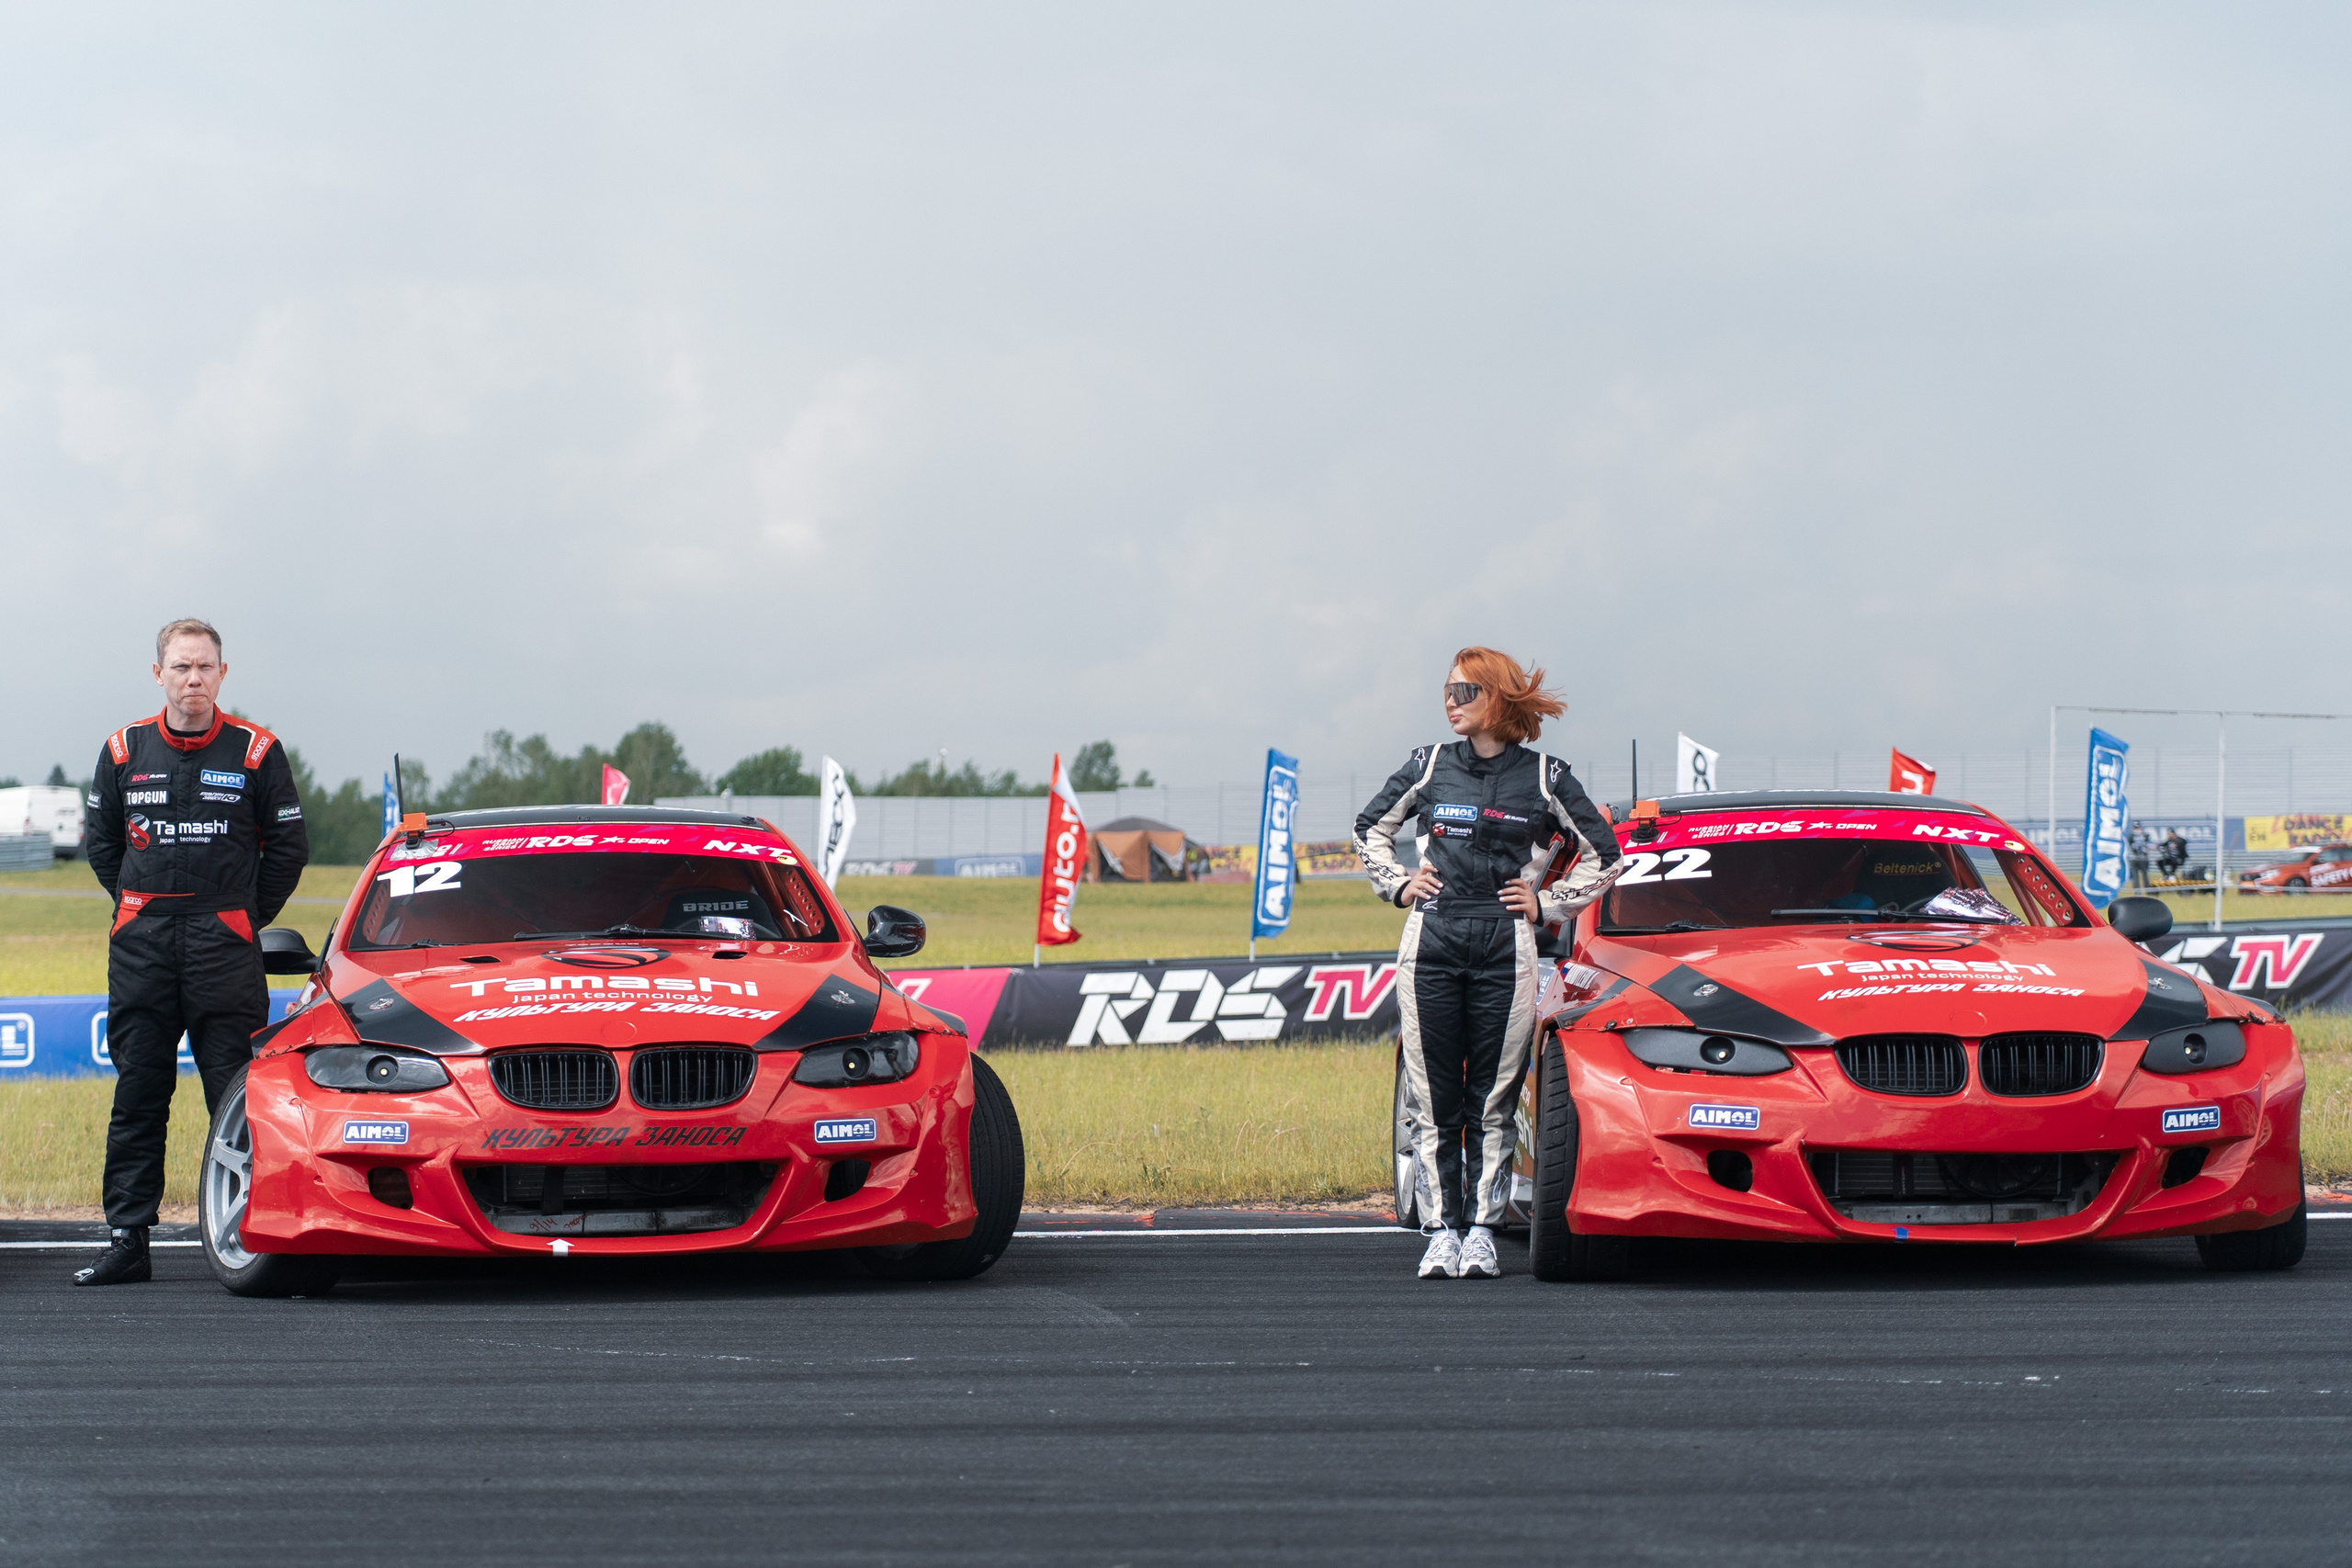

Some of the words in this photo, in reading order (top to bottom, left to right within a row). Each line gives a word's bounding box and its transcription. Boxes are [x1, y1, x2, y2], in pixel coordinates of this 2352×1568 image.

[251, 736, 269, 762] sparco
[131, 773, 150, 783] RDS
[202, 773, 243, 786] AIMOL
[1435, 807, 1475, 818] AIMOL
[1482, 808, 1506, 819] RDS
[1734, 820, 1805, 835] RDS
[2094, 758, 2123, 890] AIMOL
[180, 835, 211, 843] technology
[525, 834, 598, 849] RDS
[1912, 824, 2000, 843] NXT
[703, 840, 792, 858] NXT
[1614, 848, 1713, 886] 22
[377, 861, 462, 897] 12
[683, 900, 749, 912] BRIDE
[1797, 959, 2056, 976] Tamashi
[2228, 933, 2324, 991] TV
[1917, 972, 2024, 982] technology
[449, 975, 760, 997] Tamashi
[1817, 983, 1967, 1001] КУЛЬТУРА
[1972, 983, 2086, 997] ЗАНОСА
[582, 989, 713, 1003] technology
[452, 1001, 638, 1022] КУЛЬТУРА
[639, 1002, 781, 1021] ЗАНОСА
[1067, 966, 1304, 1047] RDS
[1303, 963, 1397, 1021] TV
[1691, 1109, 1756, 1125] AIMOL
[2165, 1111, 2218, 1128] AIMOL
[345, 1125, 405, 1139] AIMOL
[482, 1127, 630, 1149] КУЛЬТУРА
[635, 1126, 748, 1147] ЗАНОСА
[817, 1123, 874, 1139] AIMOL
